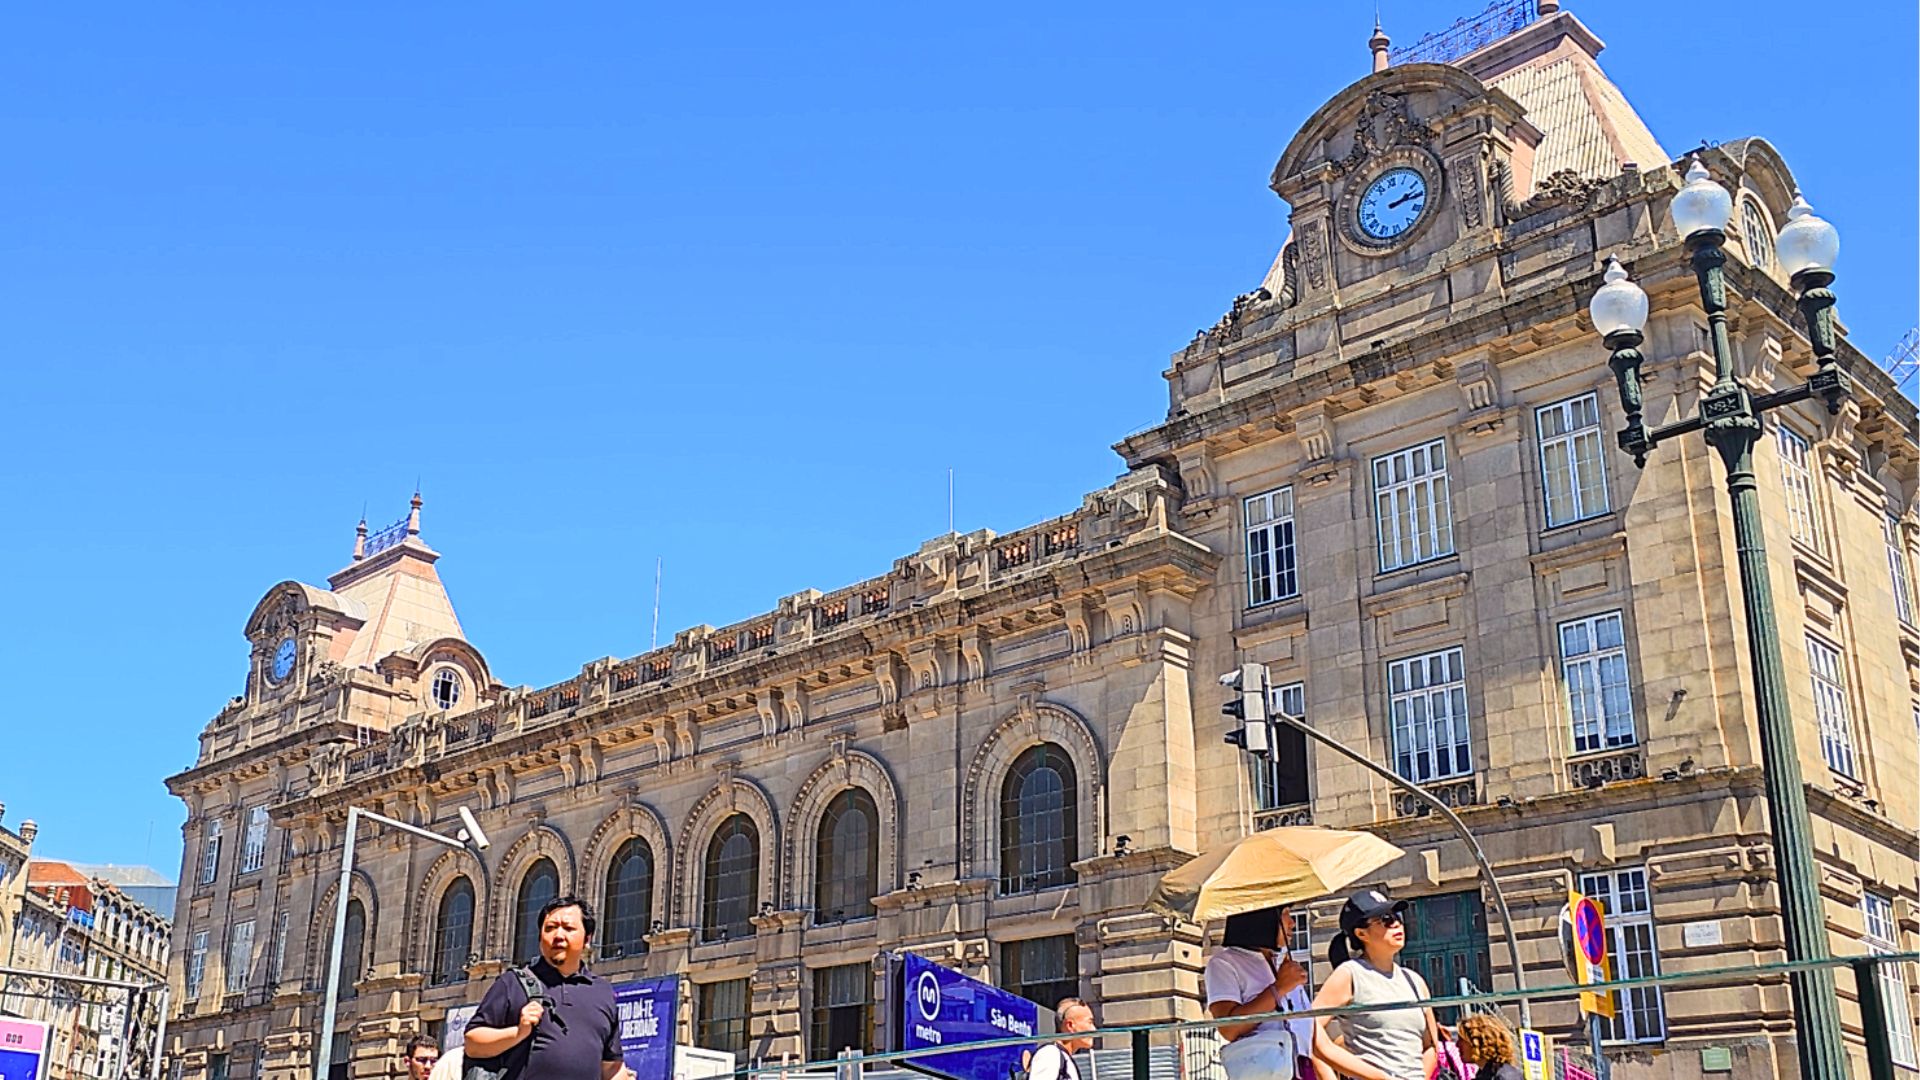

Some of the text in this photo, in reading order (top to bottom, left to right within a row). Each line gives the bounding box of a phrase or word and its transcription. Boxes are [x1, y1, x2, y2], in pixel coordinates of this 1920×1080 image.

[616, 1002, 632, 1020] TRO
[990, 1007, 1032, 1038] São Bento
[916, 1023, 942, 1045] metro
